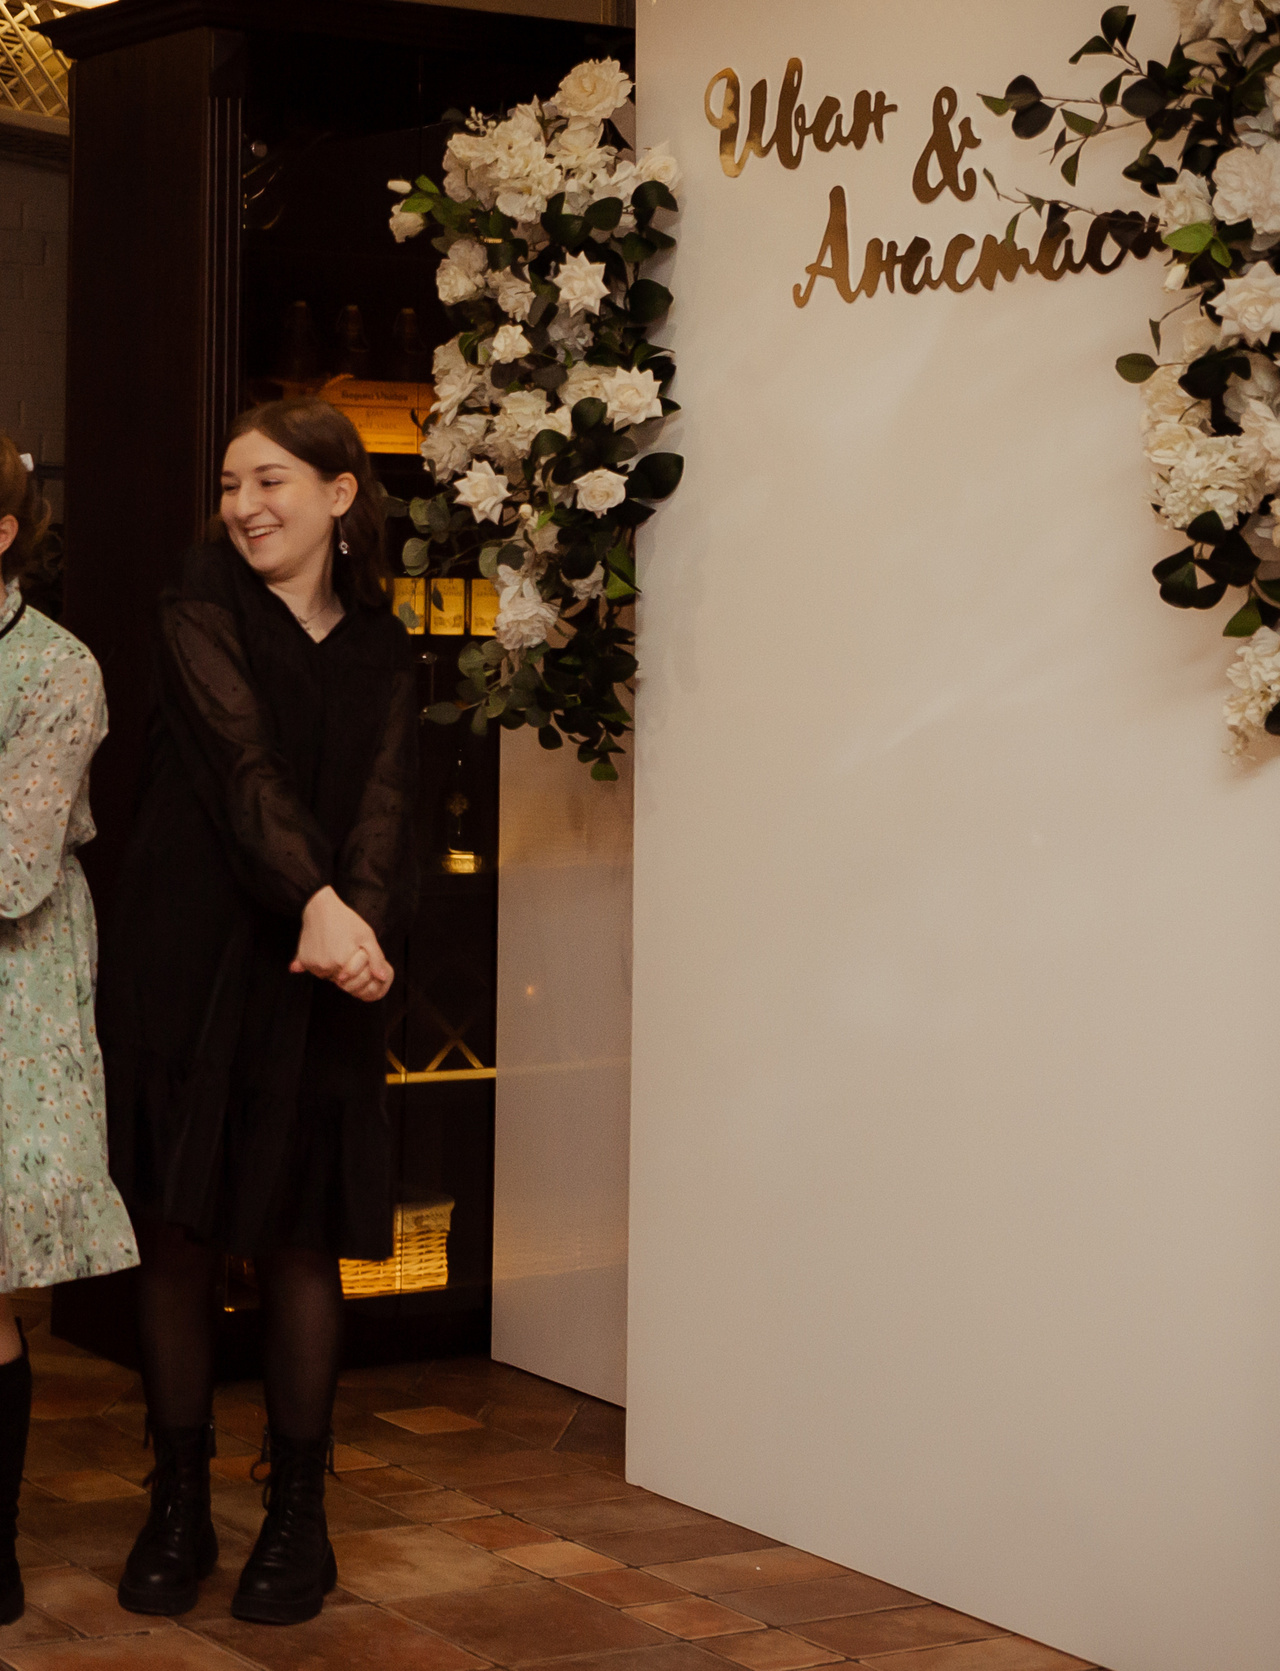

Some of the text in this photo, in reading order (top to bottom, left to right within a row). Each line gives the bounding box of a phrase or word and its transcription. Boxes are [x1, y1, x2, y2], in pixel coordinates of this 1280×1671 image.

[703, 56, 983, 204] Иван &
[791, 184, 1170, 309] Анастаси
